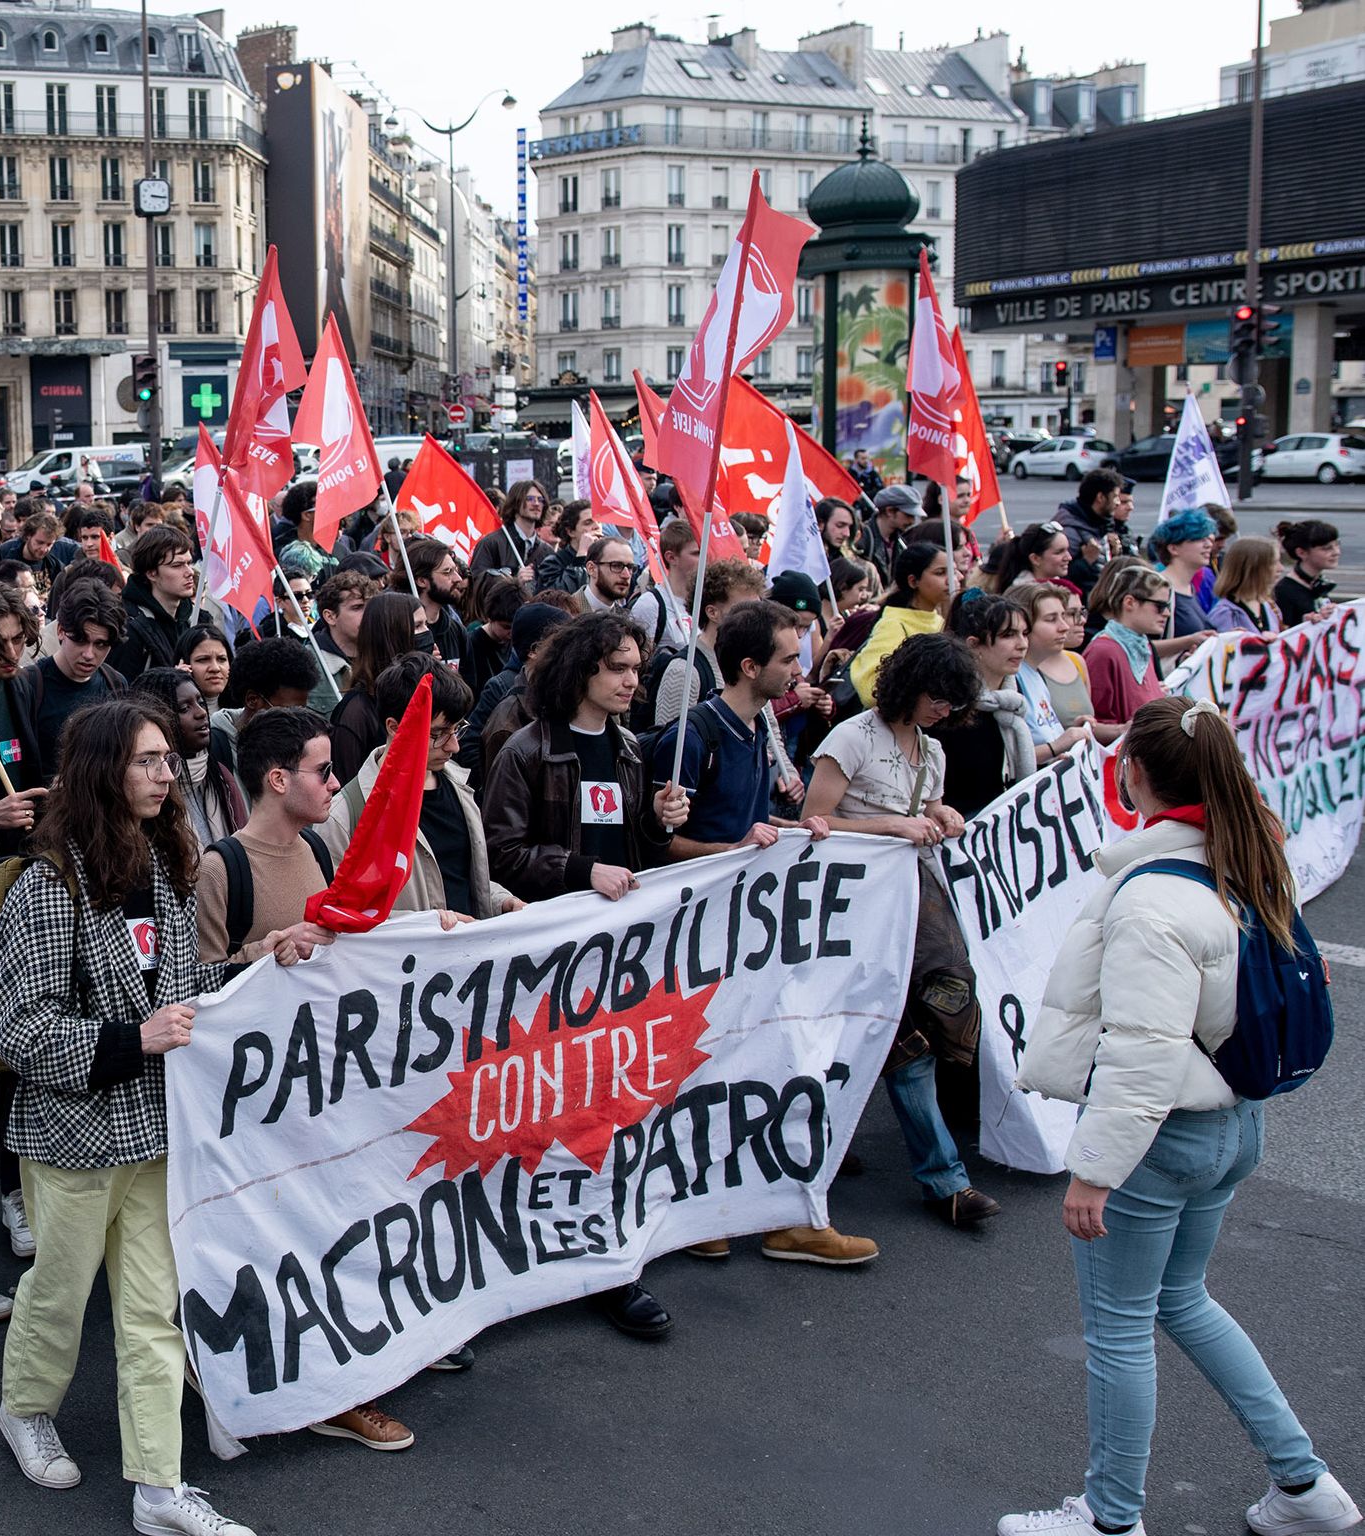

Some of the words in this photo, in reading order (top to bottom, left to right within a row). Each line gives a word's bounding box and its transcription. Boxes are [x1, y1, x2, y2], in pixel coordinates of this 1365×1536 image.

[995, 298, 1046, 324] VILLE
[1055, 295, 1082, 318] DE
[1090, 288, 1152, 315] PARIS
[1169, 276, 1263, 307] CENTRE
[39, 385, 83, 397] CINEMA
[467, 1014, 673, 1143] CONTRE
[610, 1061, 851, 1250] PATRO
[531, 1169, 592, 1211] ET
[535, 1216, 609, 1265] LES
[181, 1156, 530, 1396] MACRON
